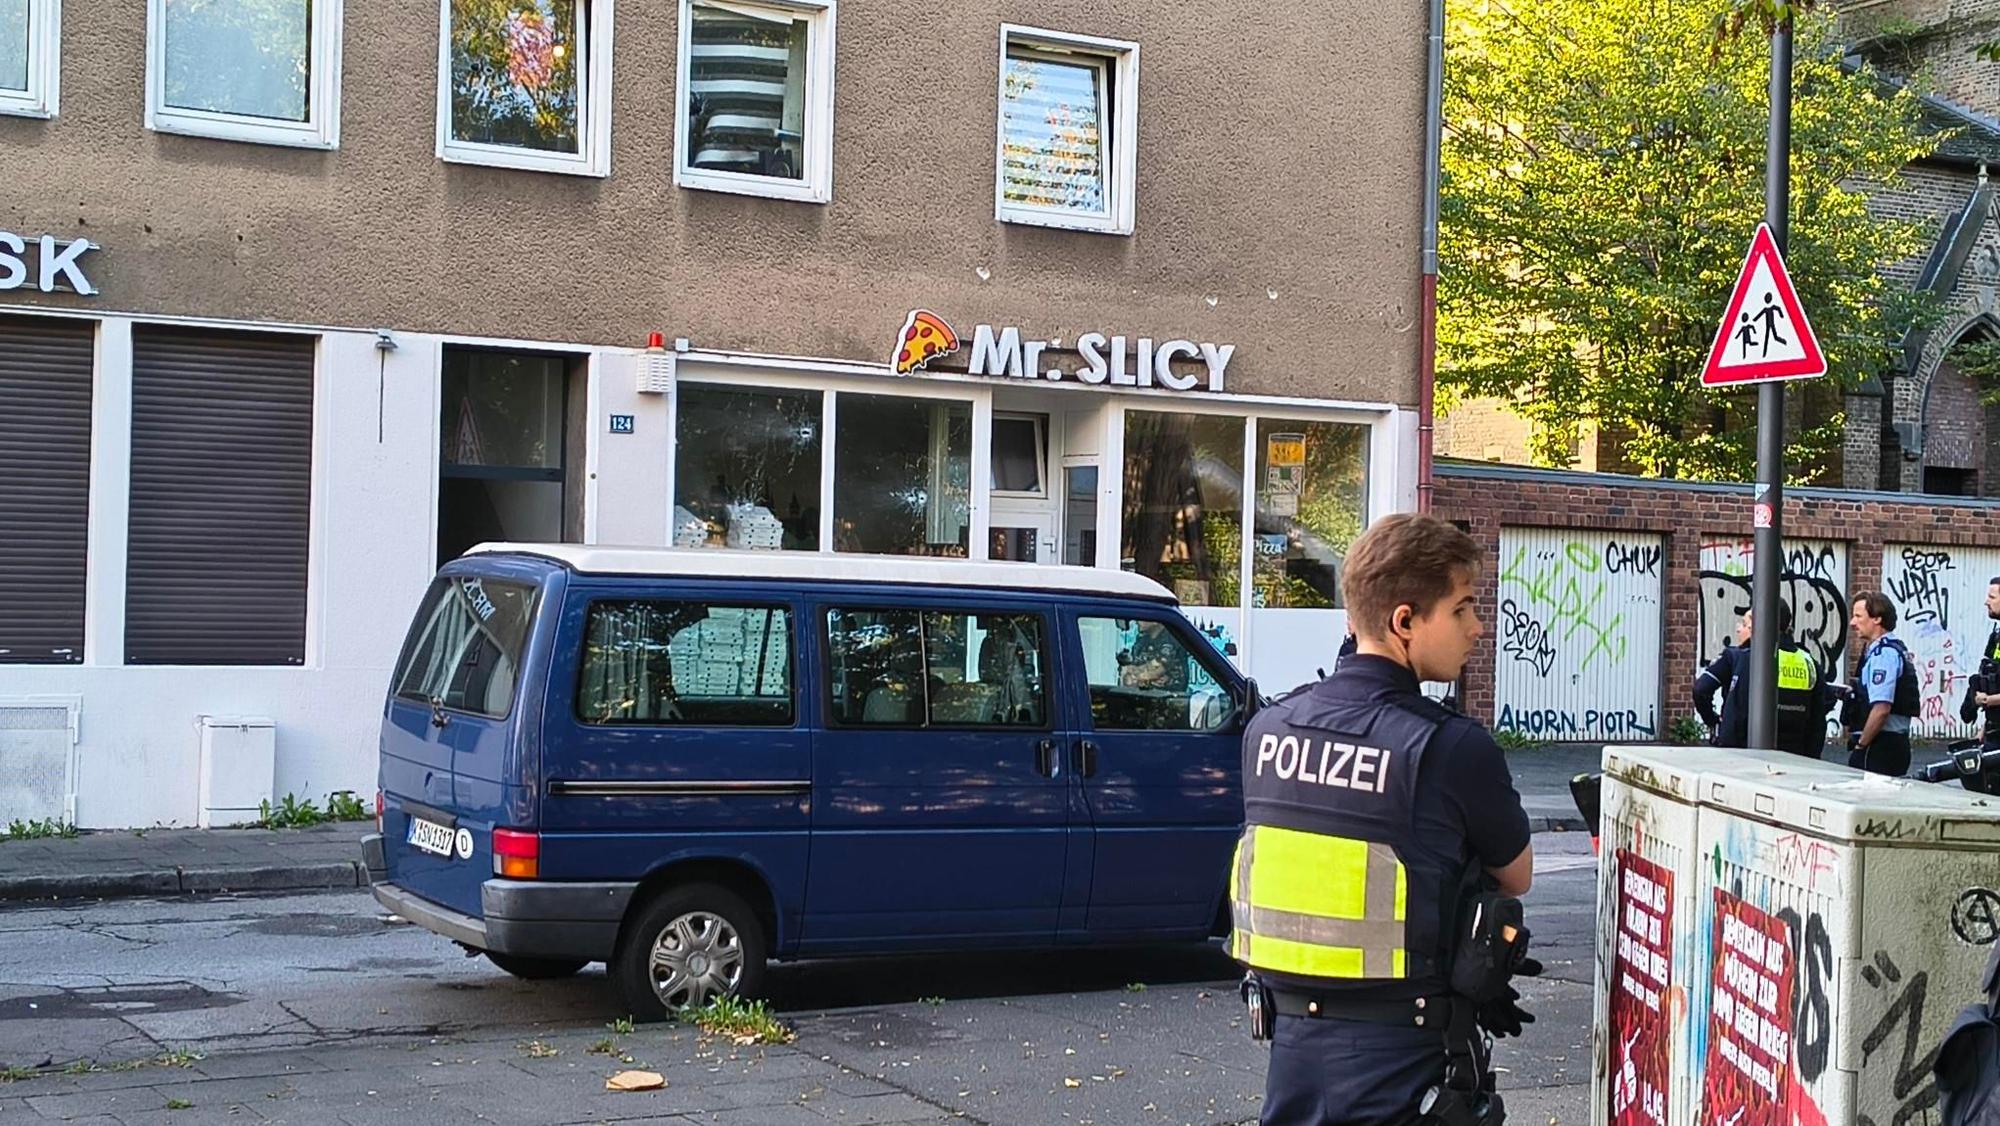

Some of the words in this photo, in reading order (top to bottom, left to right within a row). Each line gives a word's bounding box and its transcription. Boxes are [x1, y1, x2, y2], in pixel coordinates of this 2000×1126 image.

[1075, 332, 1236, 392] SLICY
[613, 416, 631, 430] 124
[1256, 734, 1391, 794] POLIZEI
[461, 835, 468, 852] D
